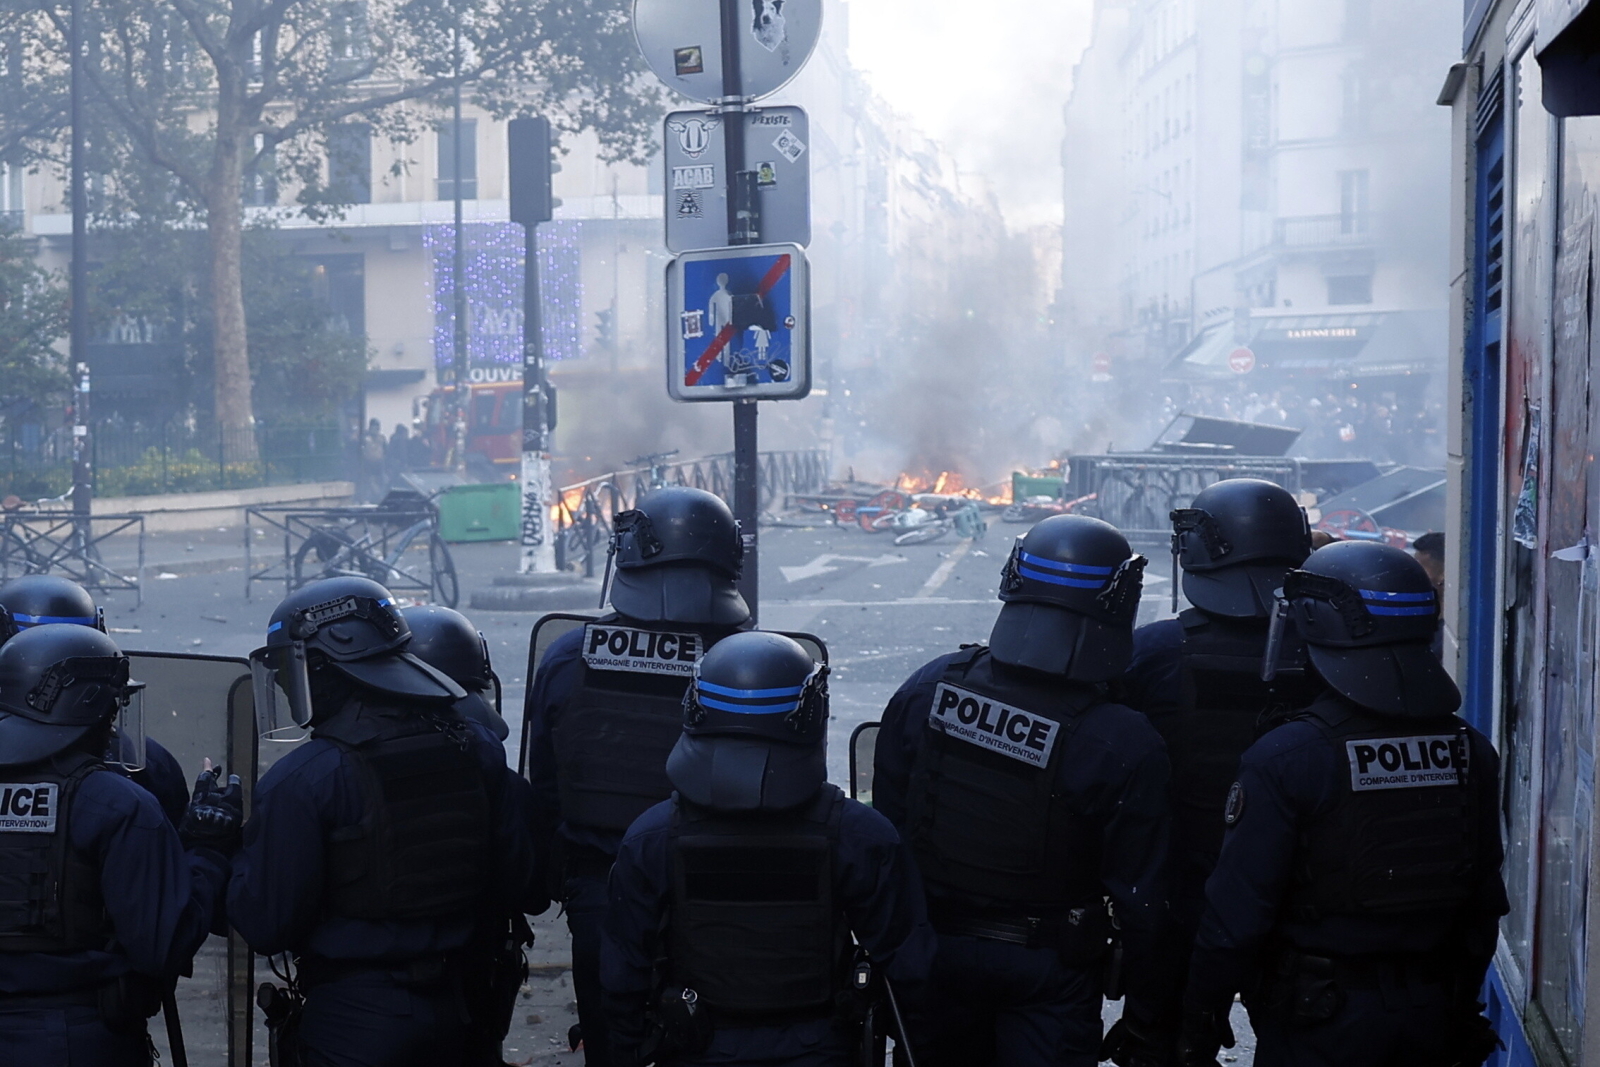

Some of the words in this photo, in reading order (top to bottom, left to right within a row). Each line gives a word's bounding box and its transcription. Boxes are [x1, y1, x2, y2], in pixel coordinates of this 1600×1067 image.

[674, 167, 713, 187] ACAB
[589, 629, 696, 662] POLICE
[587, 657, 630, 668] COMPAGNIE
[937, 688, 1052, 752] POLICE
[979, 734, 1042, 763] D'INTERVENTION
[1354, 740, 1467, 774] POLICE
[1360, 775, 1409, 786] COMPAGNIE
[1411, 772, 1459, 783] D'INTERVENT
[0, 820, 48, 828] TERVENTION
